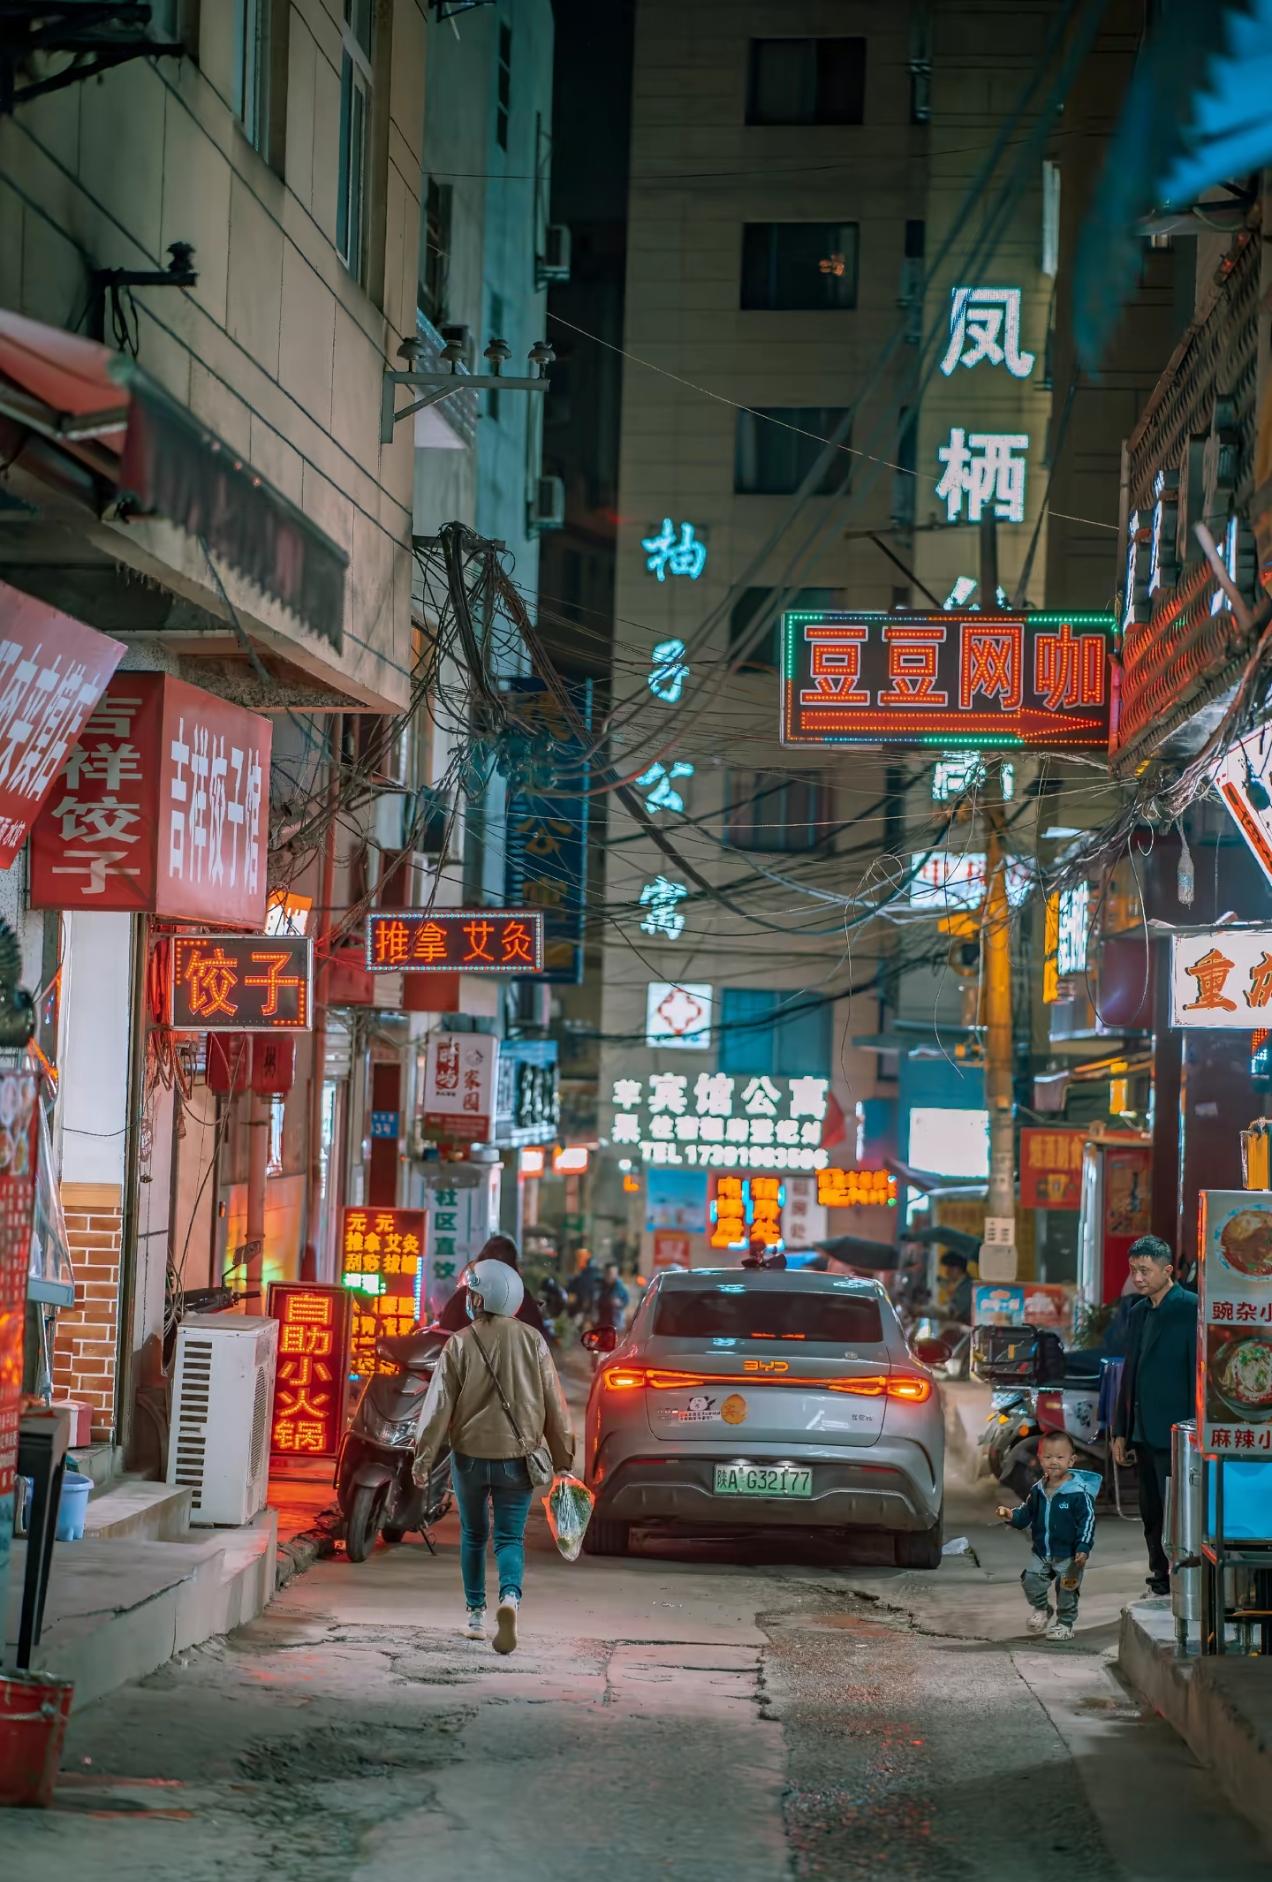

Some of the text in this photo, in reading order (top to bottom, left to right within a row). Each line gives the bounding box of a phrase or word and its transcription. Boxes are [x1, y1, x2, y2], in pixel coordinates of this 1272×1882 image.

[800, 623, 1106, 711] 豆豆网咖
[51, 691, 143, 895] 吉祥饺子
[168, 716, 262, 896] 吉祥饺子馆
[185, 947, 300, 1017] 饺子
[639, 1141, 683, 1164] TEL
[274, 1294, 333, 1451] 自助小火锅
[743, 1360, 790, 1372] BYD
